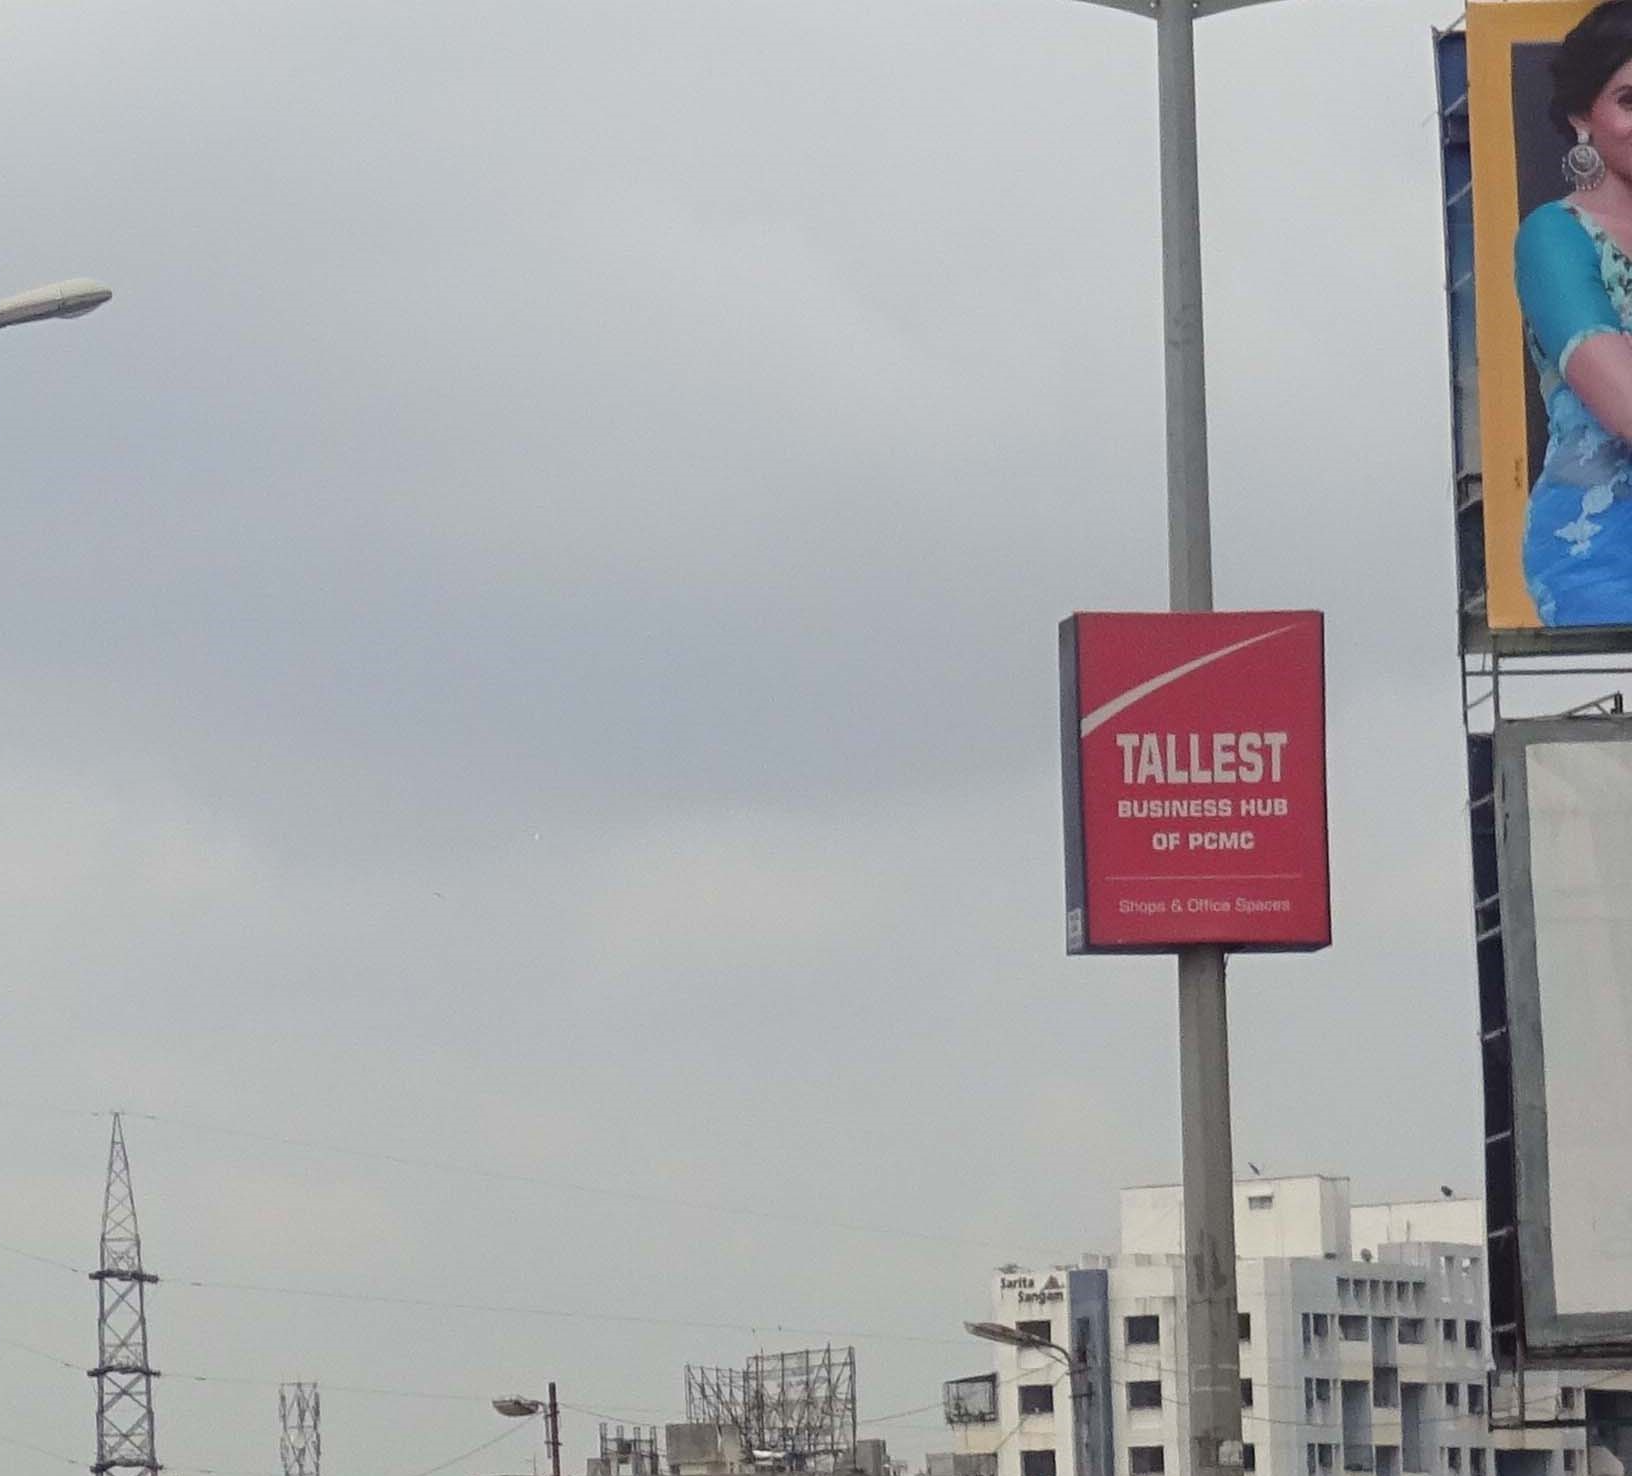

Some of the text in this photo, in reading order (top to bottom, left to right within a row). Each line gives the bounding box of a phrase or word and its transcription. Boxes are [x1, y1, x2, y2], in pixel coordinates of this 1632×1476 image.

[1115, 732, 1288, 785] TALLEST
[1118, 798, 1289, 818] BUSINESS HUB
[1151, 831, 1255, 850] OF PCMC
[1119, 897, 1291, 915] Shops & Office Spaces
